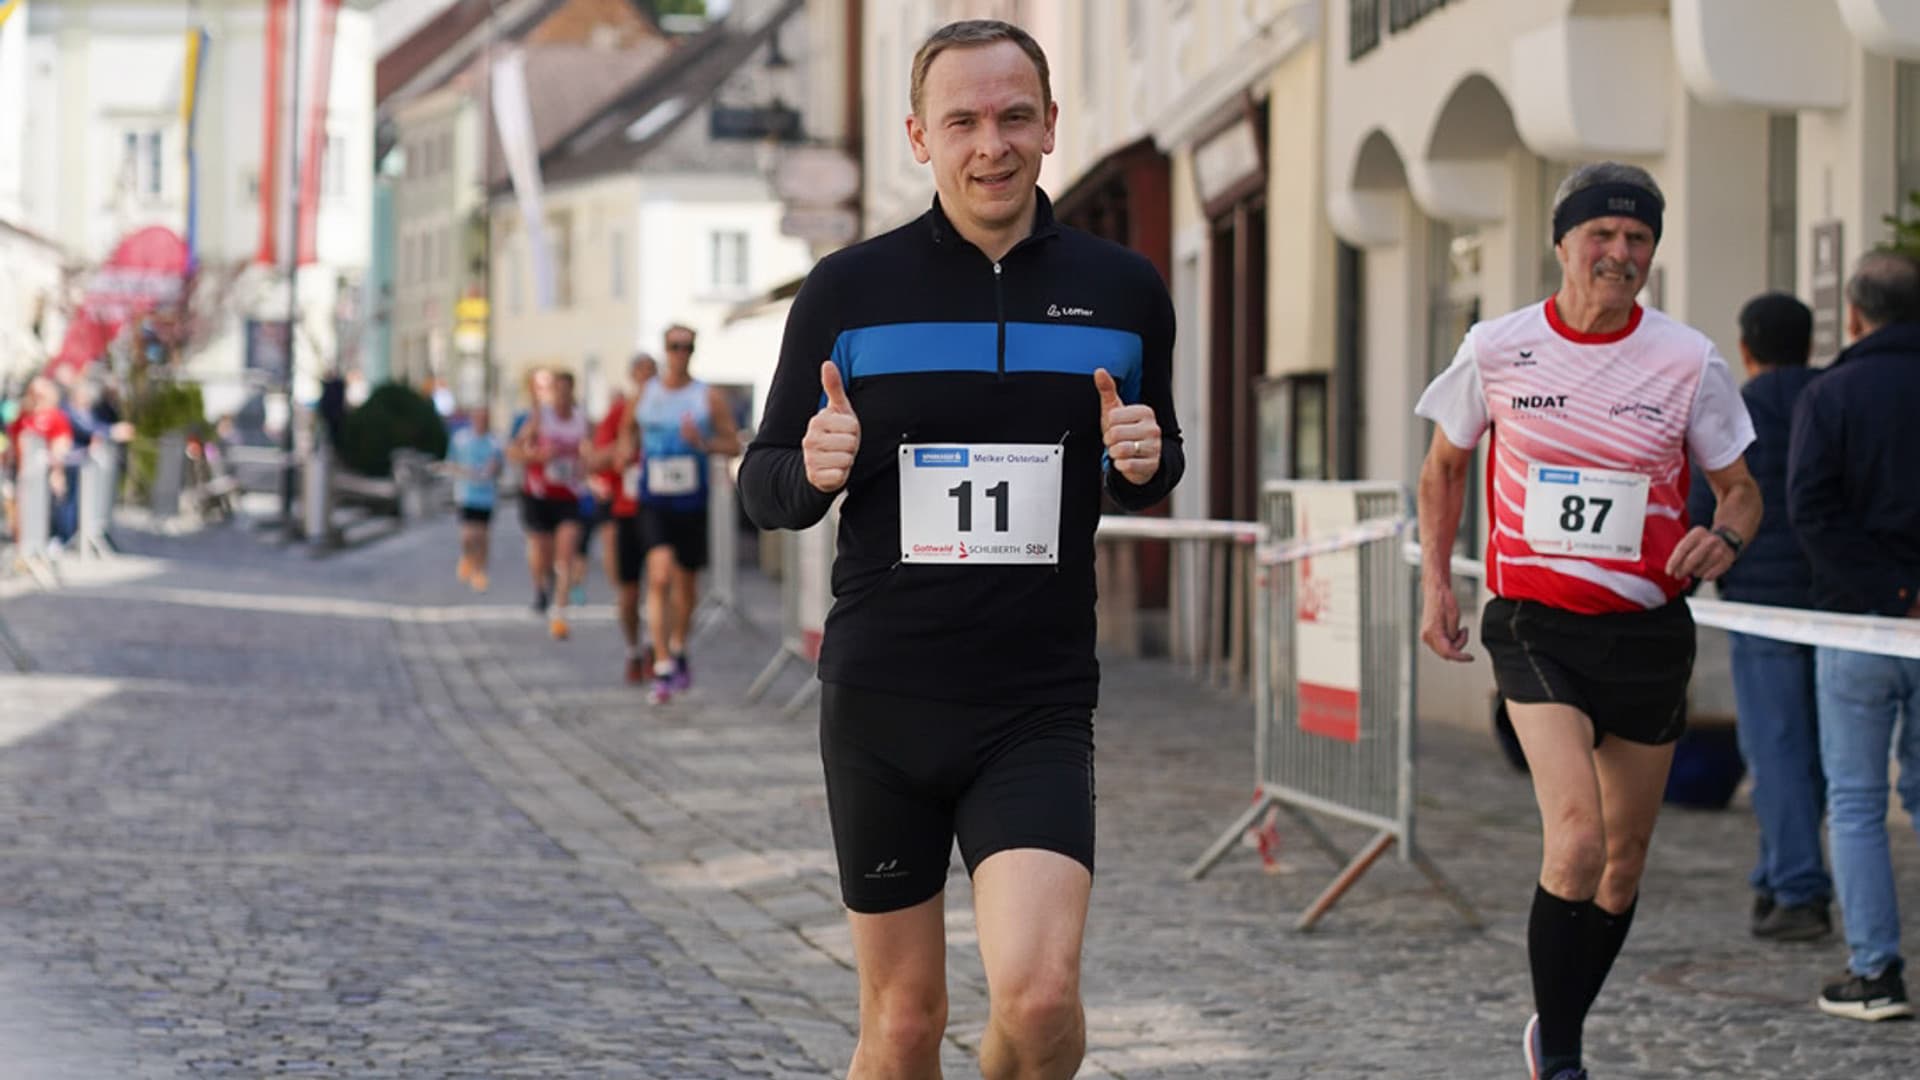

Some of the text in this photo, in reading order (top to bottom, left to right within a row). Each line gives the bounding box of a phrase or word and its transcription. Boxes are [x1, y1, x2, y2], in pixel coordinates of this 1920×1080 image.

[1511, 395, 1568, 410] INDAT
[948, 480, 1010, 532] 11
[1559, 495, 1614, 534] 87
